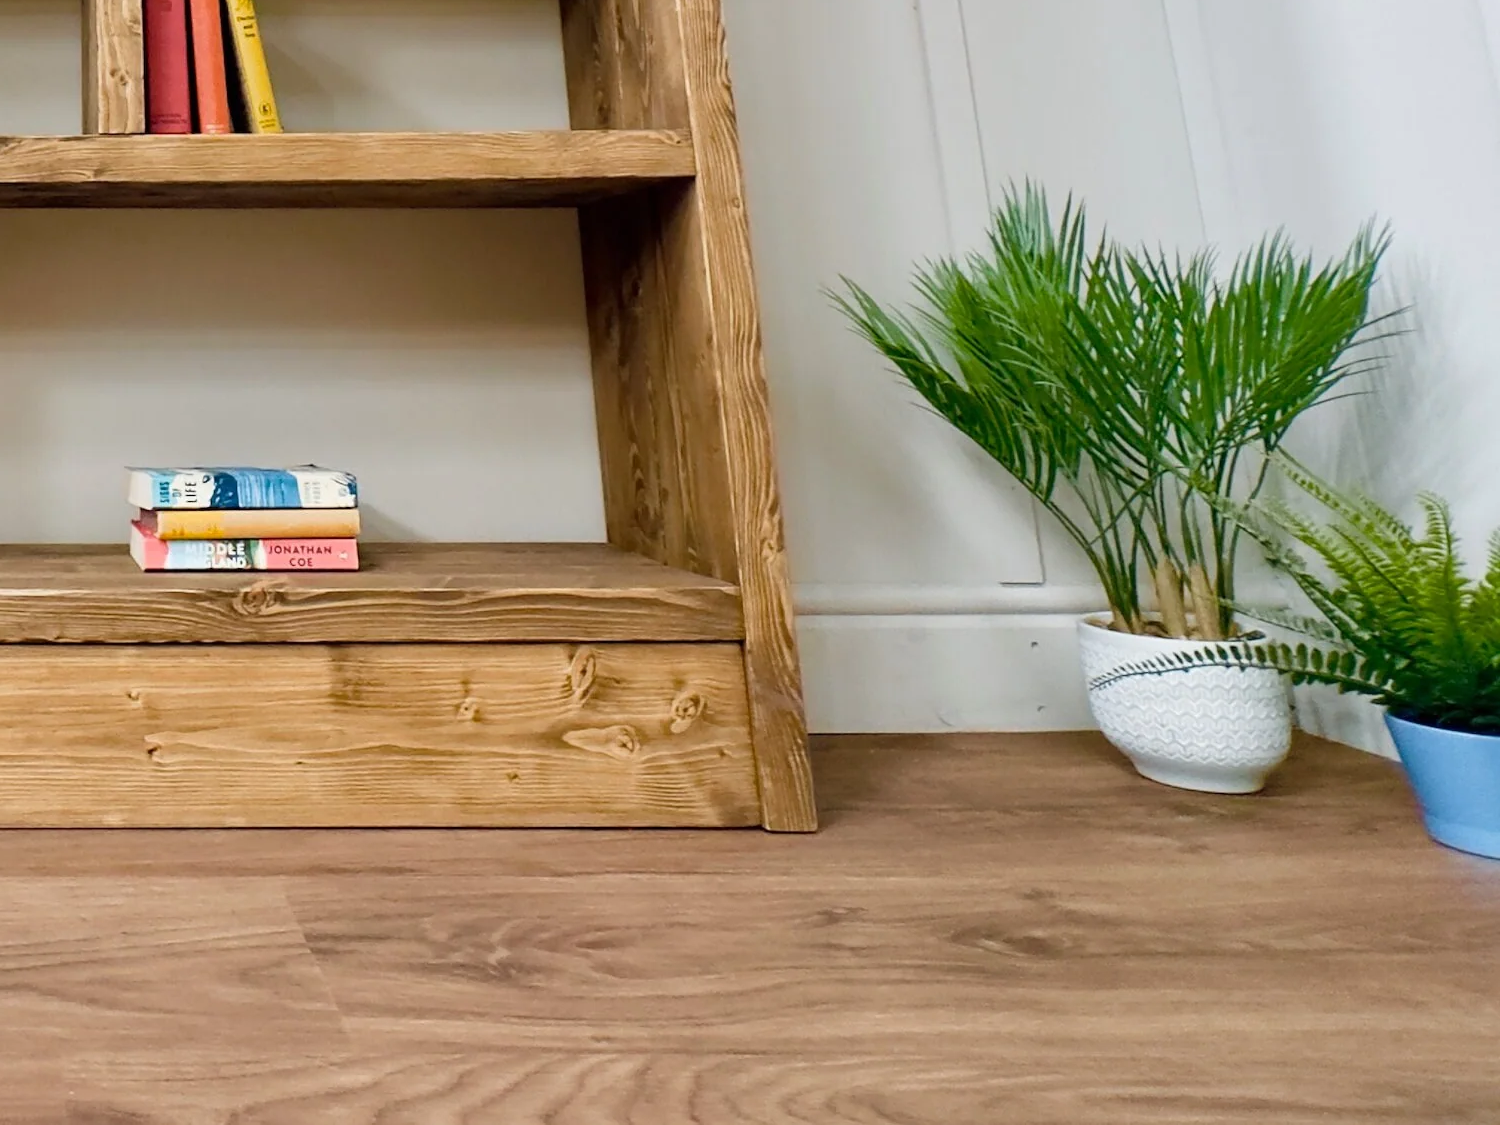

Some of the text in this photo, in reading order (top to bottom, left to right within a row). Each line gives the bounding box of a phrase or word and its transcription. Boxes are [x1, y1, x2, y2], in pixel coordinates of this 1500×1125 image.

[160, 481, 170, 503] SIGNS
[185, 482, 197, 503] LIFE
[185, 541, 245, 556] MIDDLE
[269, 546, 332, 555] JONATHAN
[289, 558, 313, 567] COE
